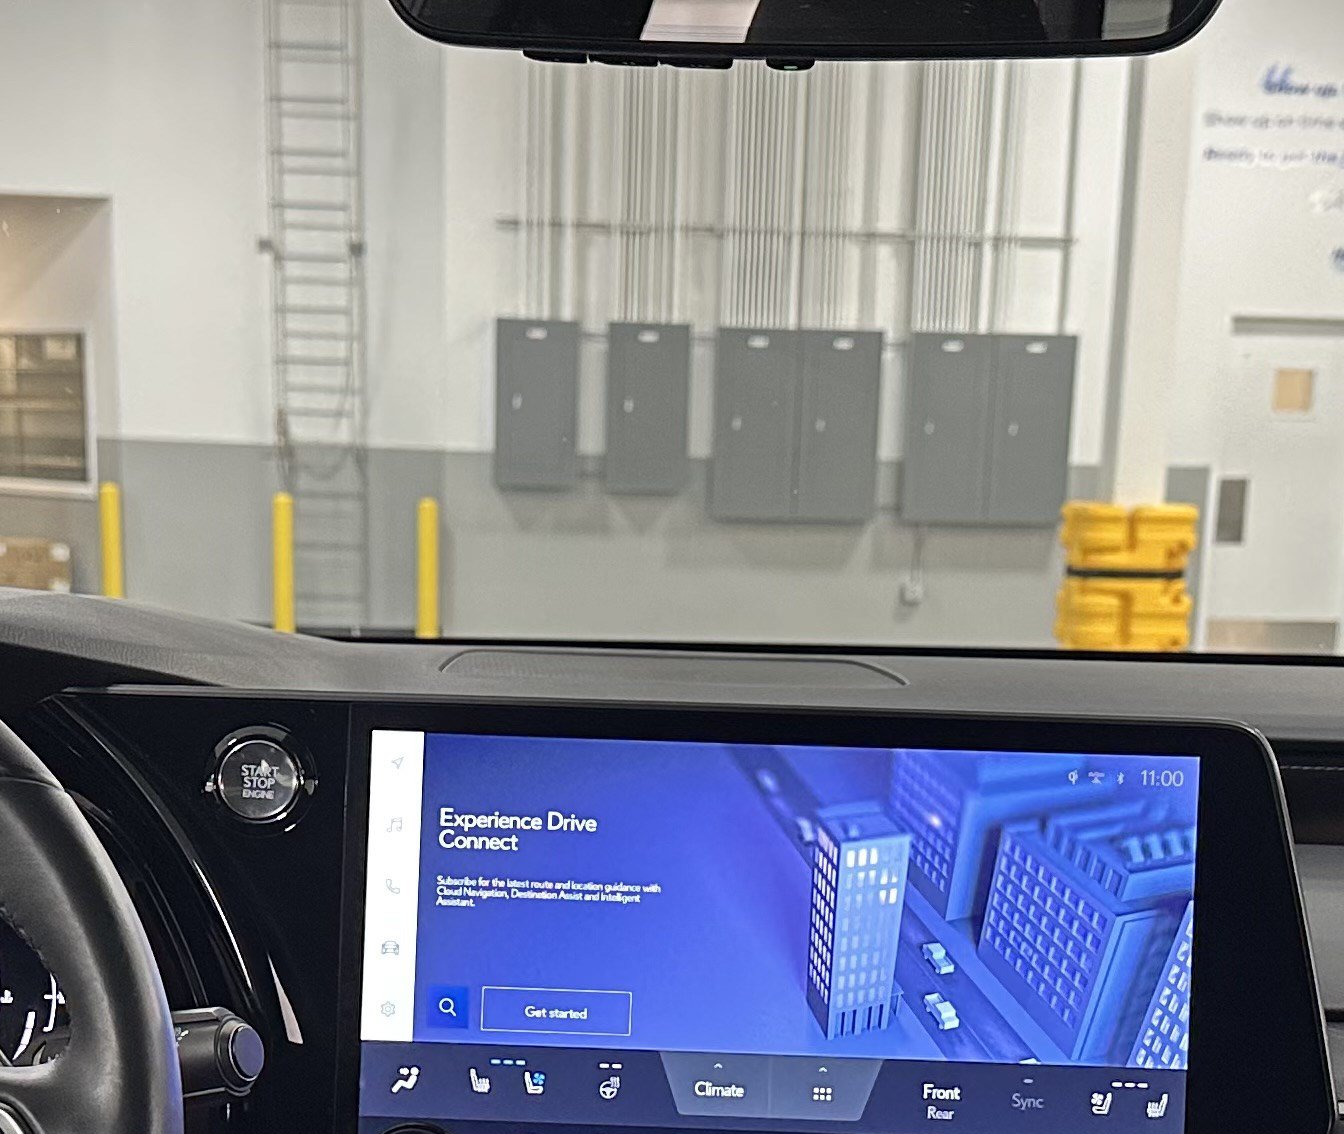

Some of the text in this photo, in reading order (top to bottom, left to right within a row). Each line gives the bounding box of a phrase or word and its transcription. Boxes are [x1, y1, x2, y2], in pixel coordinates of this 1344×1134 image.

[241, 764, 280, 778] START
[1141, 770, 1184, 787] 11:00
[243, 777, 276, 789] STOP
[242, 790, 274, 800] ENGINE
[439, 807, 597, 832] Experience Drive
[438, 829, 519, 851] Connect
[436, 875, 477, 887] Subscribe
[478, 876, 490, 887] for
[491, 877, 506, 888] the
[506, 878, 530, 888] latest
[530, 879, 554, 889] route
[554, 880, 570, 890] and
[571, 880, 604, 891] location
[604, 882, 641, 893] guidance
[435, 896, 475, 907] Assistant.
[436, 885, 641, 904] Cloud Navigation, Destination Assist and Intelligent
[524, 1005, 588, 1021] Get started
[694, 1082, 745, 1098] Climate
[923, 1084, 961, 1101] Front
[1011, 1093, 1045, 1110] Sync
[927, 1105, 954, 1121] Rear
